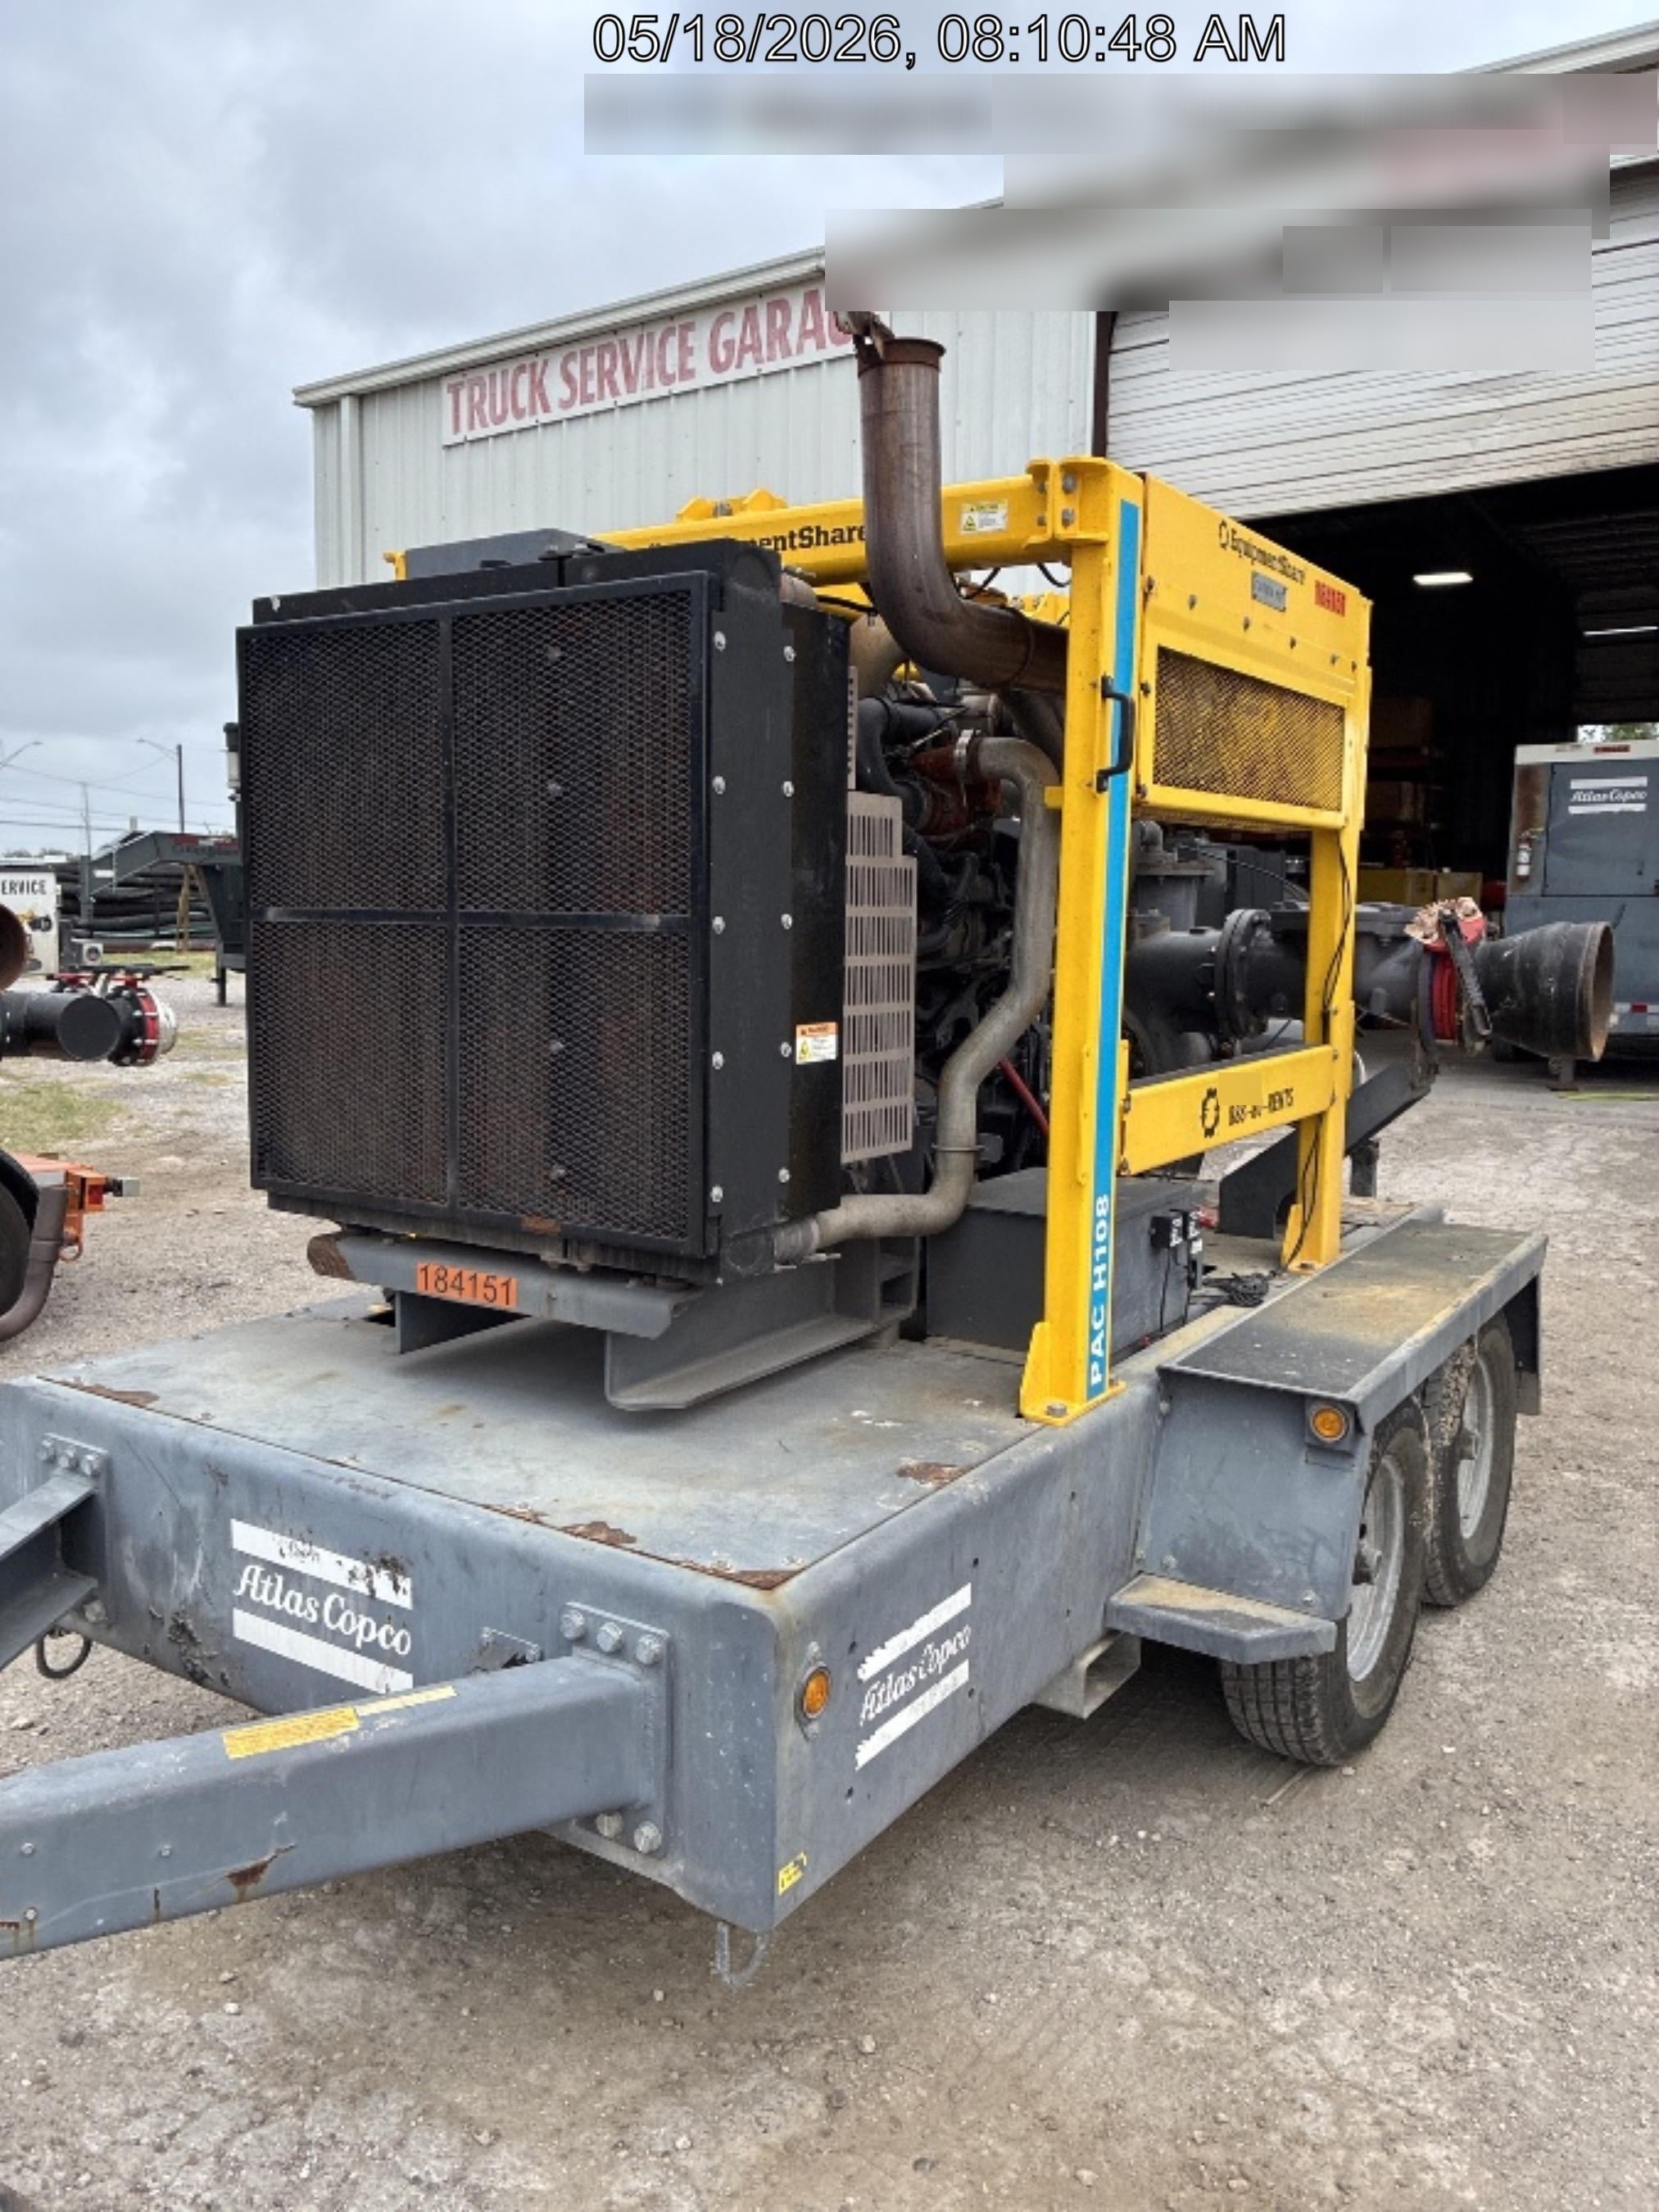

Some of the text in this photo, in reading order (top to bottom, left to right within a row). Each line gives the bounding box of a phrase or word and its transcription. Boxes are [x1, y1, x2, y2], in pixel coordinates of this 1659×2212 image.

[446, 288, 852, 435] TRUCK SERVICE GARA
[1, 878, 47, 895] ERVICE
[419, 1262, 514, 1307] 184151
[1090, 1194, 1109, 1386] PAC H108
[233, 1565, 412, 1655] Atlas Copco
[859, 1665, 918, 1727] Atlas
